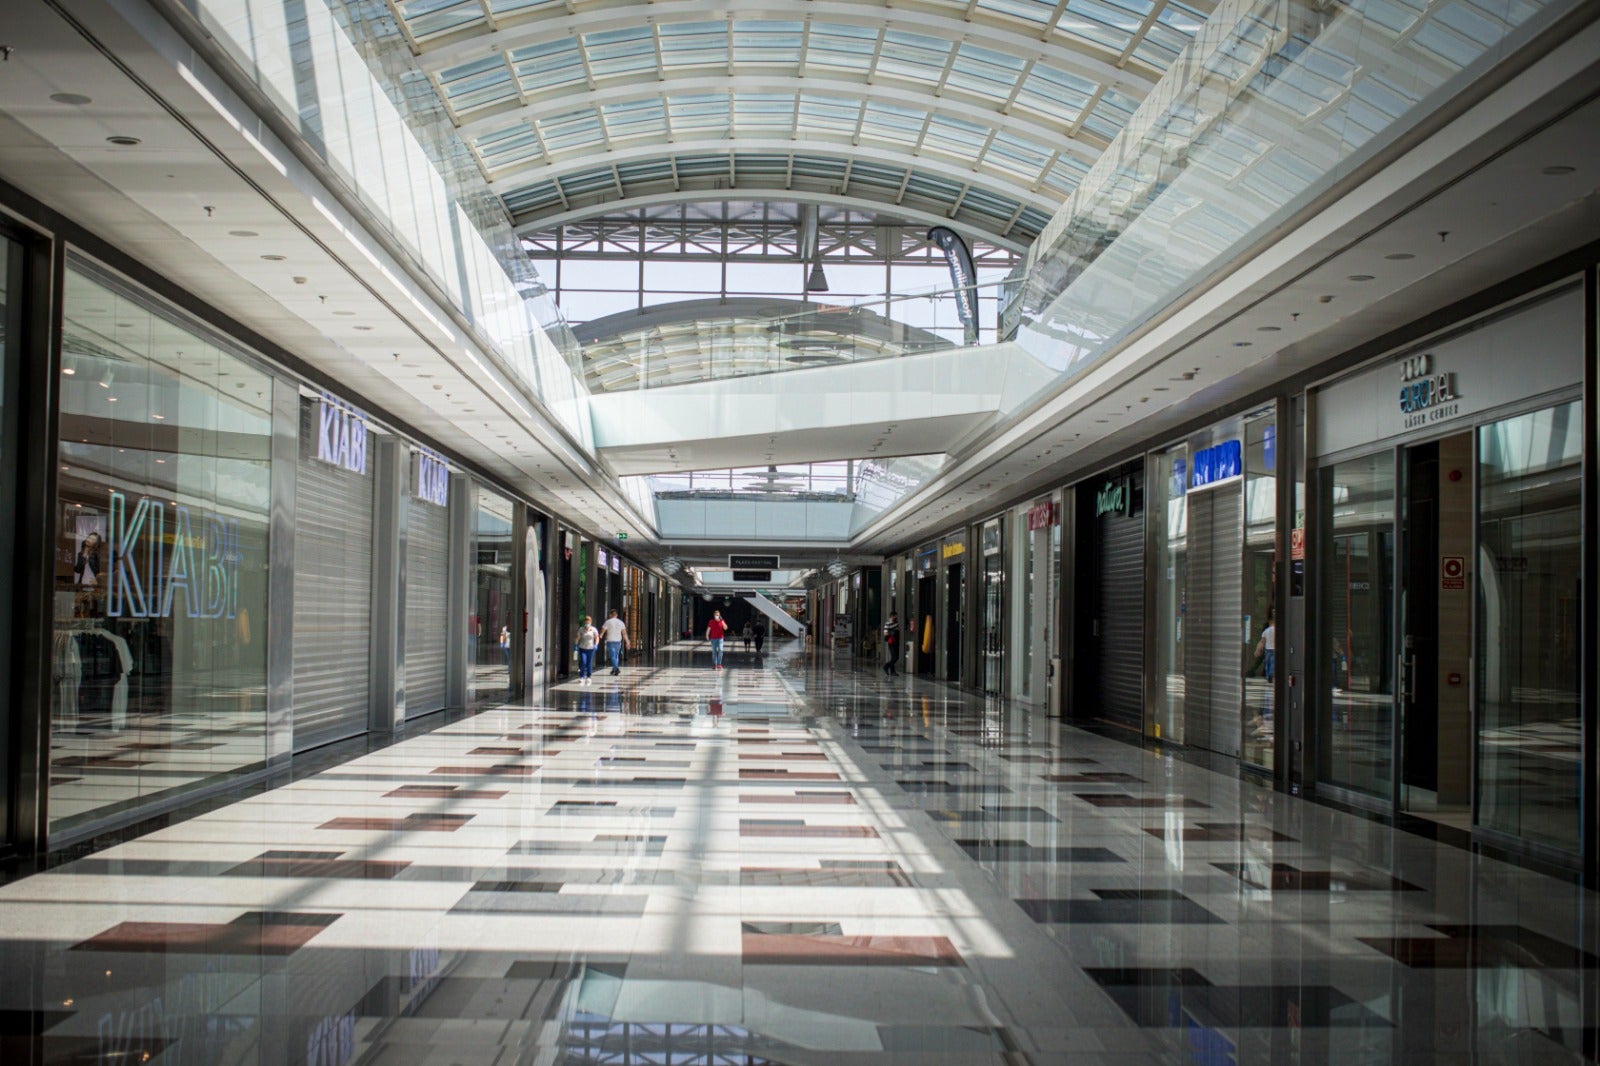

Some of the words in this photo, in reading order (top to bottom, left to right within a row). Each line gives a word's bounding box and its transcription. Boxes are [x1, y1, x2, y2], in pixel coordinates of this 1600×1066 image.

[318, 401, 368, 476] KIABI
[418, 454, 449, 507] KIABI
[107, 492, 240, 619] KIABI
